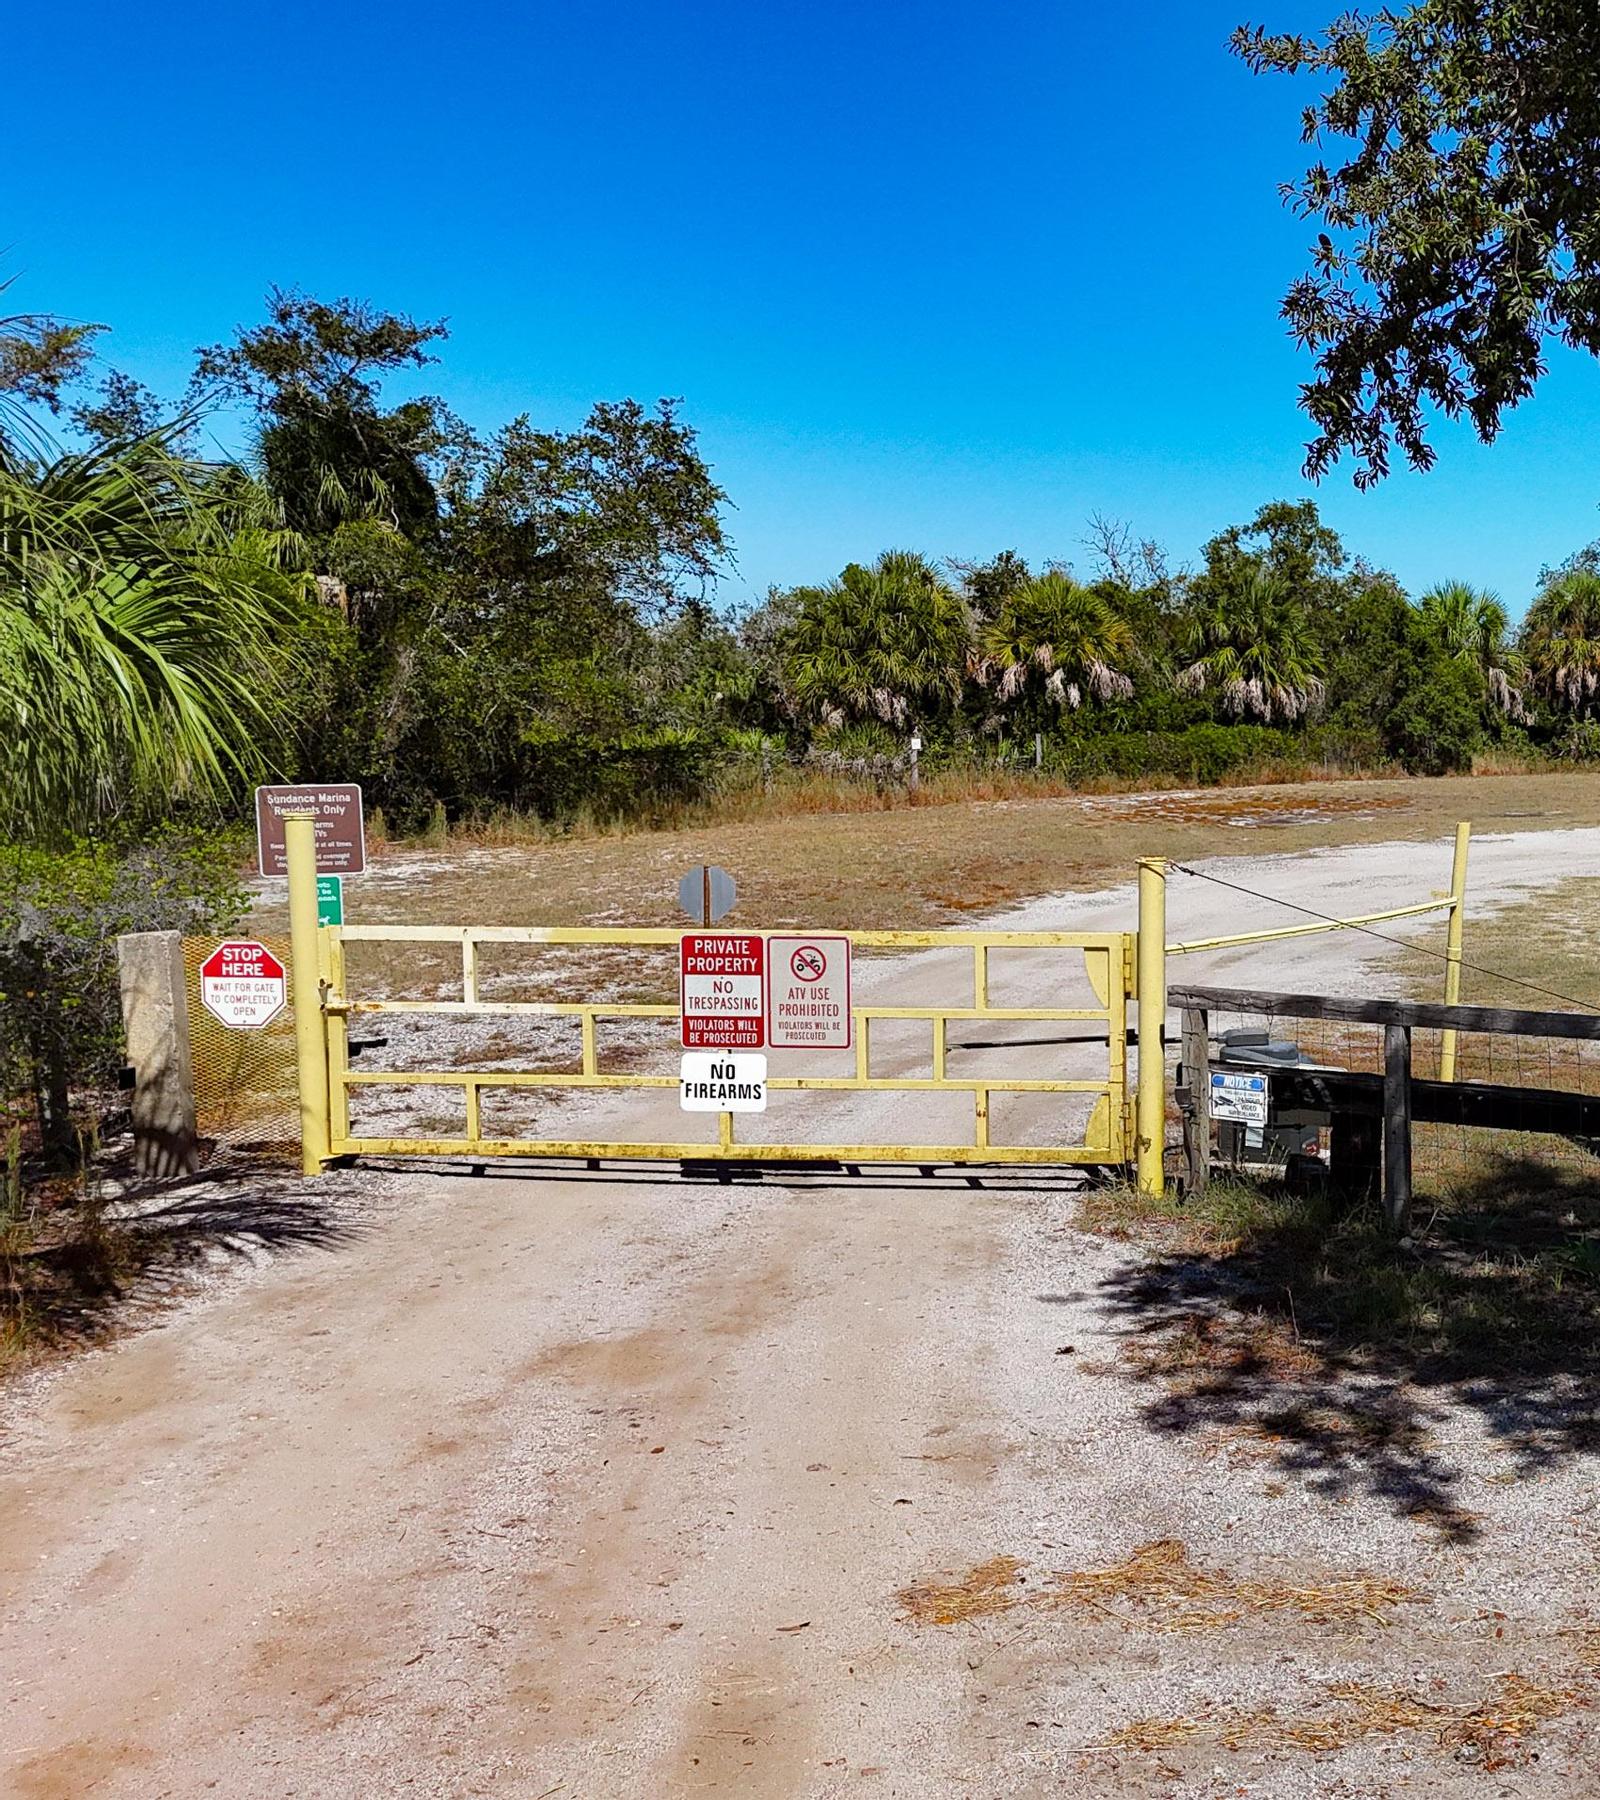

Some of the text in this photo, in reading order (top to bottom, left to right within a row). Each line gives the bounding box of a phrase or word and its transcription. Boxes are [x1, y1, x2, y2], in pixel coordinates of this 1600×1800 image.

[267, 793, 351, 804] Sundance Marina
[274, 805, 346, 816] Residents Only
[694, 939, 750, 954] PRIVATE
[222, 948, 263, 961] STOP
[221, 963, 264, 976] HERE
[687, 957, 758, 972] PROPERTY
[213, 983, 275, 993] WAIT FOR GATE
[713, 980, 733, 994] NO
[210, 994, 277, 1004] TO COMPLETELY
[788, 987, 830, 1001] ATV USE
[688, 996, 758, 1010] TRESPASSING
[233, 1007, 256, 1015] OPEN
[778, 1003, 839, 1017] PROHIBITED
[688, 1019, 758, 1031] VIOLATORS WILL
[778, 1021, 840, 1030] VIOLATORS WILL BE
[689, 1032, 757, 1044] BE PROSECUTED
[785, 1031, 826, 1040] PROSECUTED
[710, 1064, 736, 1080] NO
[1224, 1074, 1253, 1090] NOTICE
[685, 1082, 761, 1100] FIREARMS
